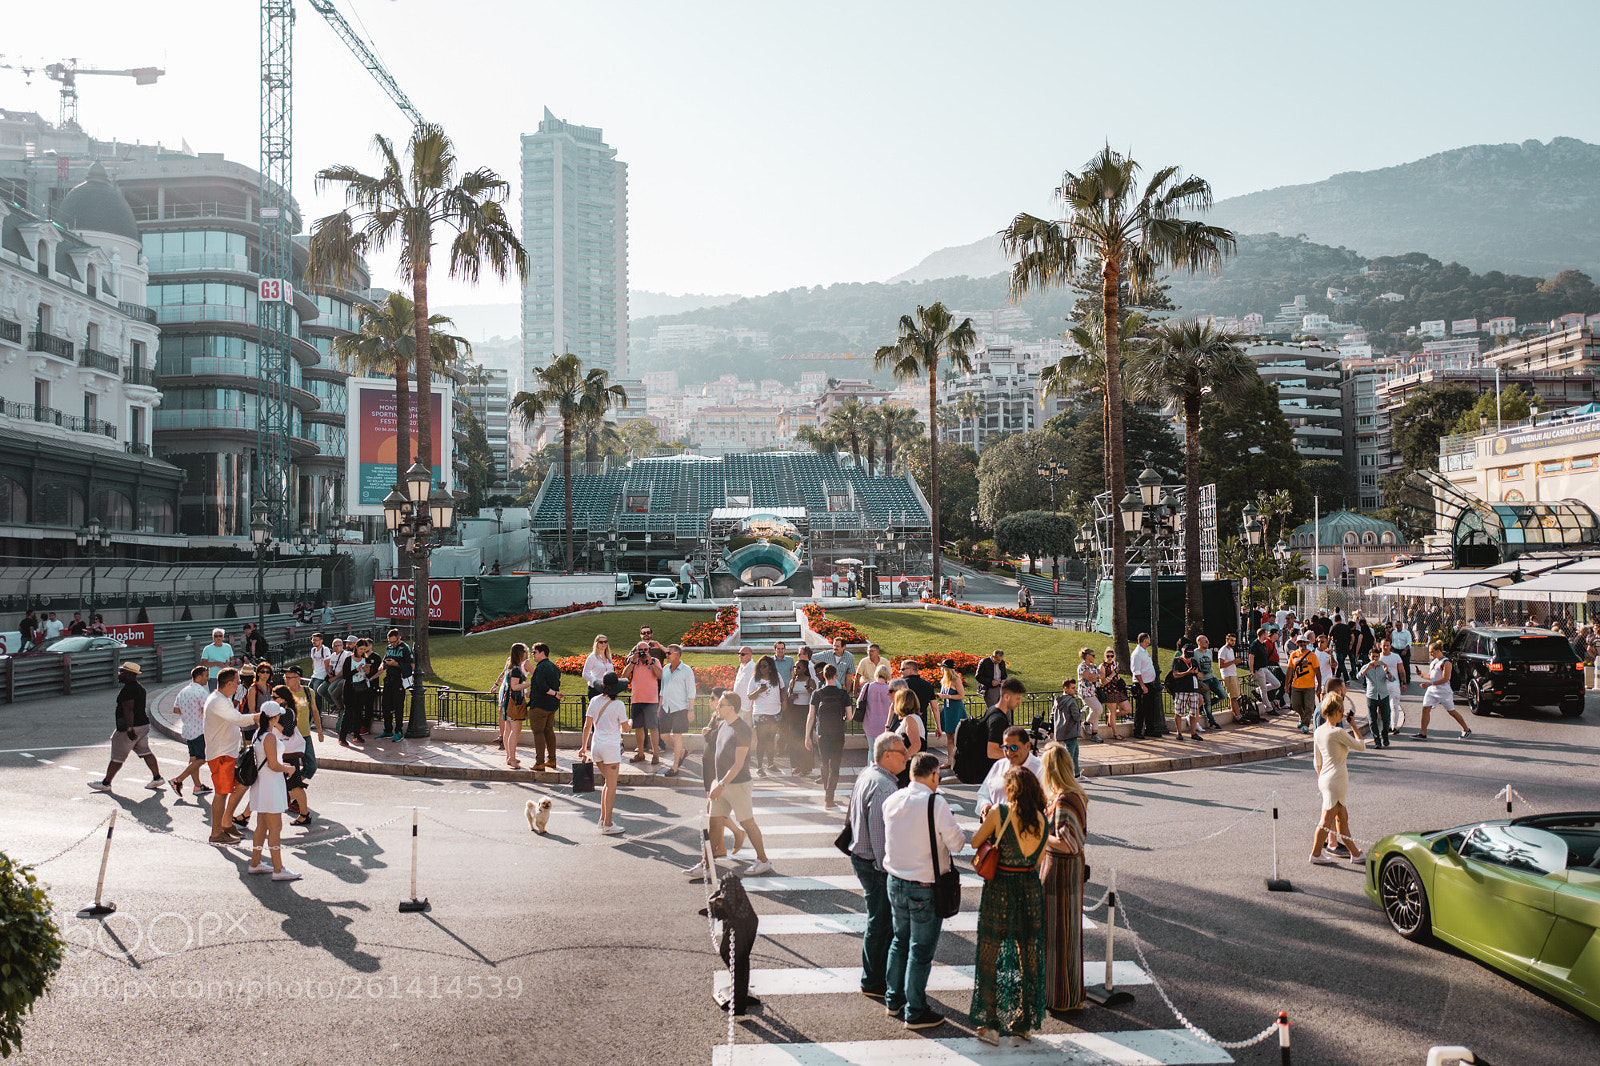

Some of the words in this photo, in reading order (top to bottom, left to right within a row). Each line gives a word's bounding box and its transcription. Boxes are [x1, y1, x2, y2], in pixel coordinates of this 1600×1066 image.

[261, 281, 280, 299] G3
[1511, 433, 1543, 445] BIENVENUE
[1543, 431, 1552, 440] AU
[1552, 428, 1574, 438] CASINO
[1575, 423, 1591, 434] CAFÉ
[390, 584, 441, 606] CASO
[390, 606, 398, 616] DE
